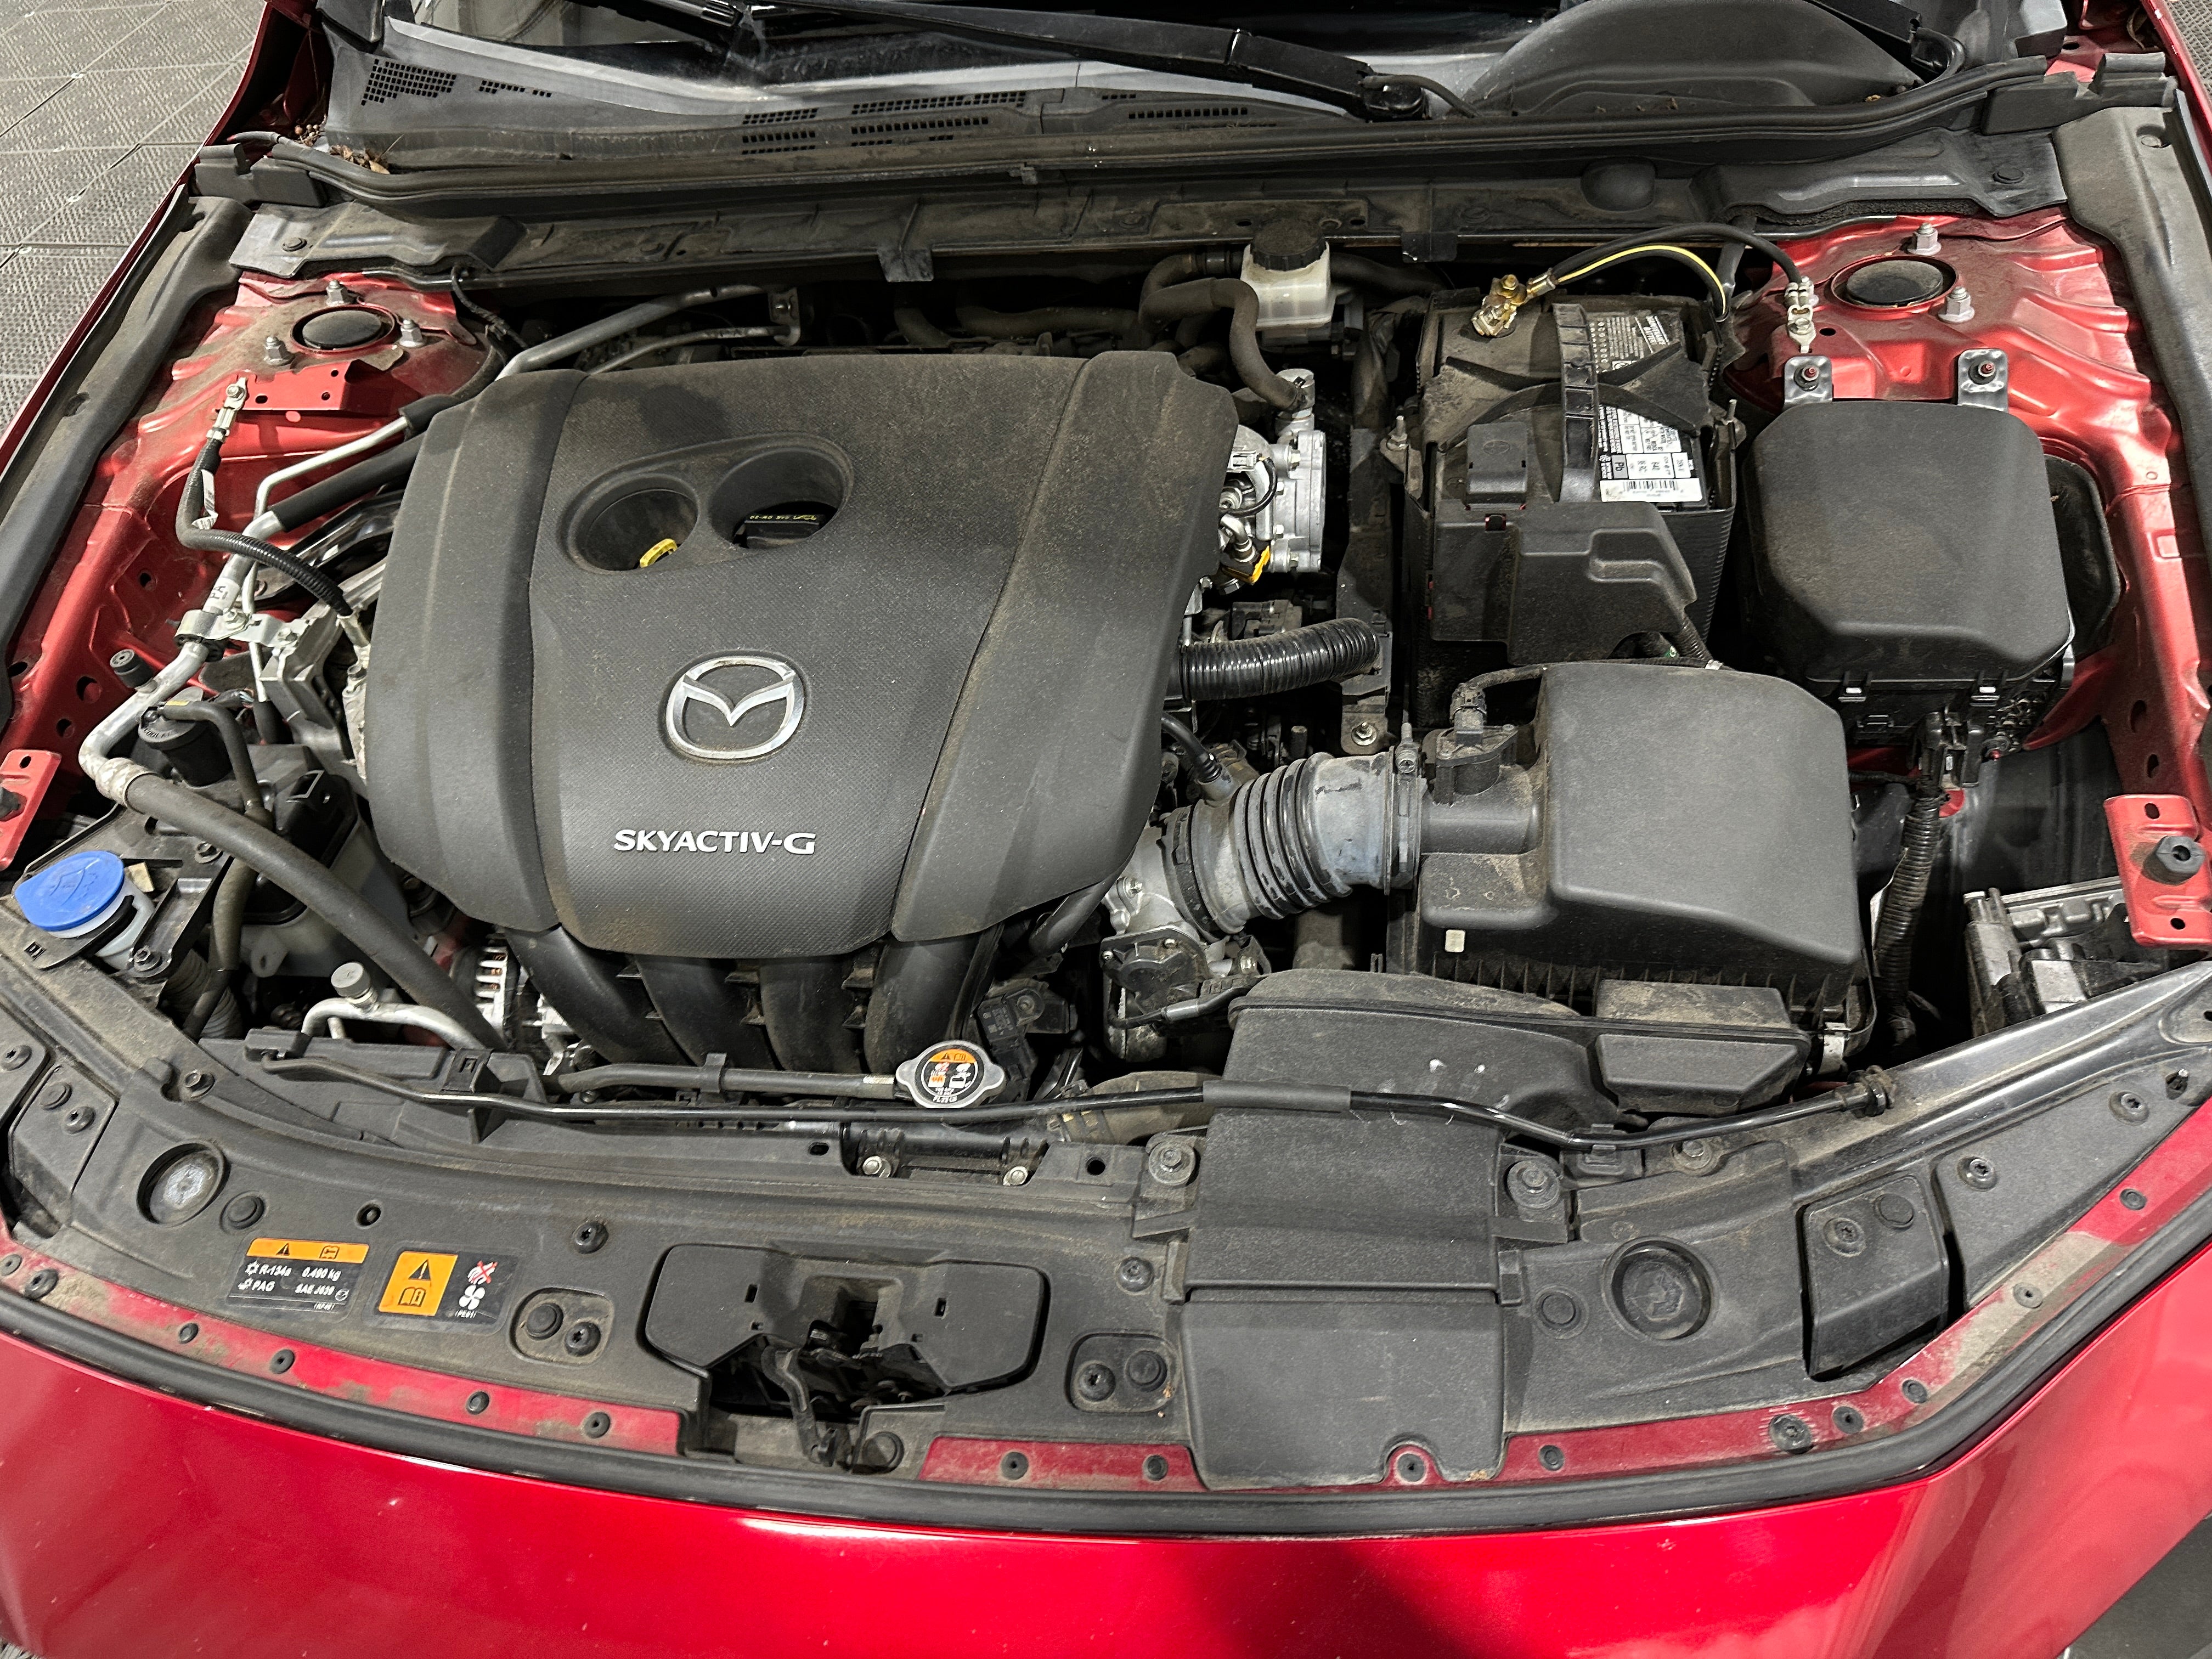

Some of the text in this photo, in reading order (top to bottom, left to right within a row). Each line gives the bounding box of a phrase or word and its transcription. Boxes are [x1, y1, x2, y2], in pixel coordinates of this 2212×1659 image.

[1614, 462, 1624, 471] Pb
[613, 829, 816, 855] SKYACTIV-G
[259, 1263, 292, 1277] R-134a
[328, 1268, 342, 1282] kg
[252, 1279, 336, 1296] PAG SAE J639
